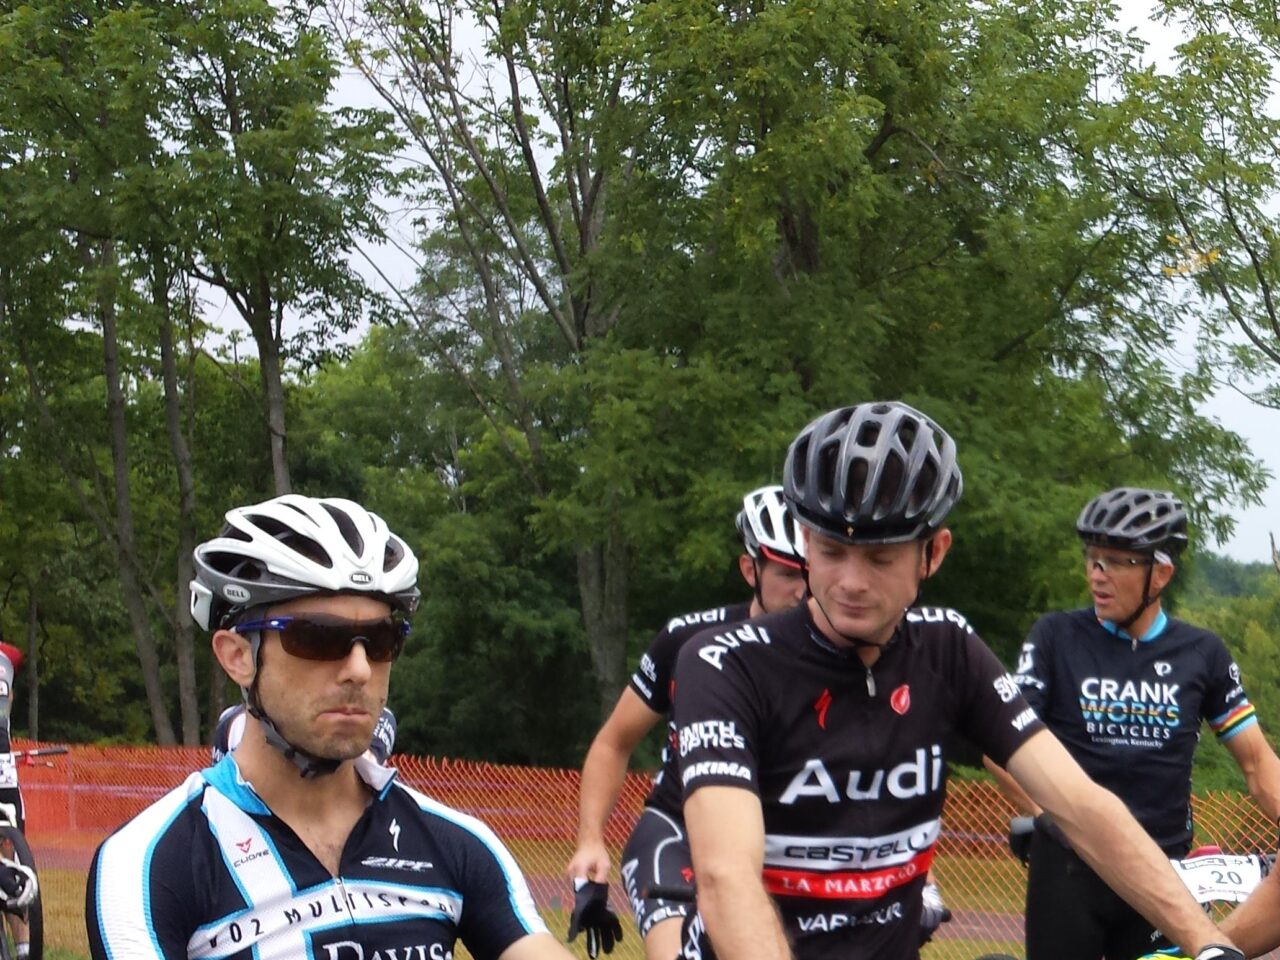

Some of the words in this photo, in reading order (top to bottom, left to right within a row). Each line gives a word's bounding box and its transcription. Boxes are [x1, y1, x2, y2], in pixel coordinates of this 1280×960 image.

[352, 573, 370, 583] BELL
[226, 587, 247, 599] BELL
[668, 607, 726, 633] Audi
[699, 623, 771, 671] Audi
[1081, 677, 1180, 706] CRANK
[1079, 698, 1181, 728] WORKS
[680, 720, 735, 741] MITH
[1086, 721, 1171, 740] BICYCLES
[1130, 738, 1164, 750] Kentucky
[779, 744, 942, 805] Audi
[233, 849, 270, 868] CUORE
[361, 856, 434, 873] ZIPP
[782, 877, 812, 892] LA
[1210, 870, 1243, 885] 20
